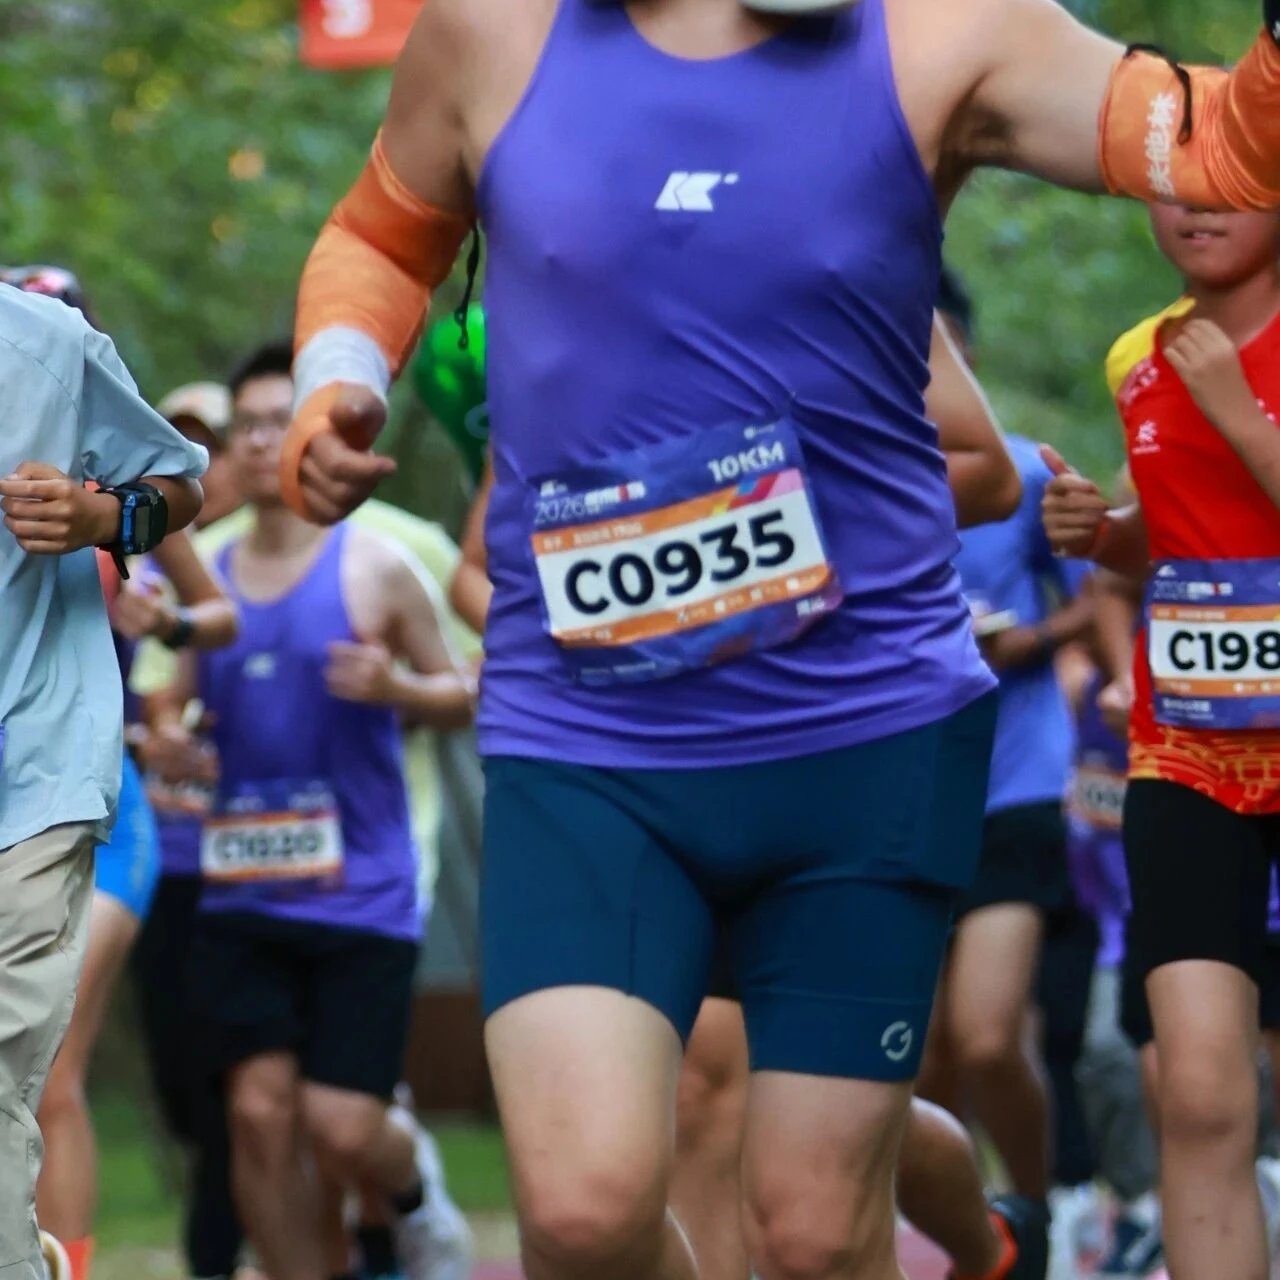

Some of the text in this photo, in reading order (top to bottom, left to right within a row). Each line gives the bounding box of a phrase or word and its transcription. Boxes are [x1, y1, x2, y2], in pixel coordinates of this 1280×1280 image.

[707, 440, 786, 484] 10KM
[564, 510, 795, 615] C0935
[1168, 630, 1280, 672] C198
